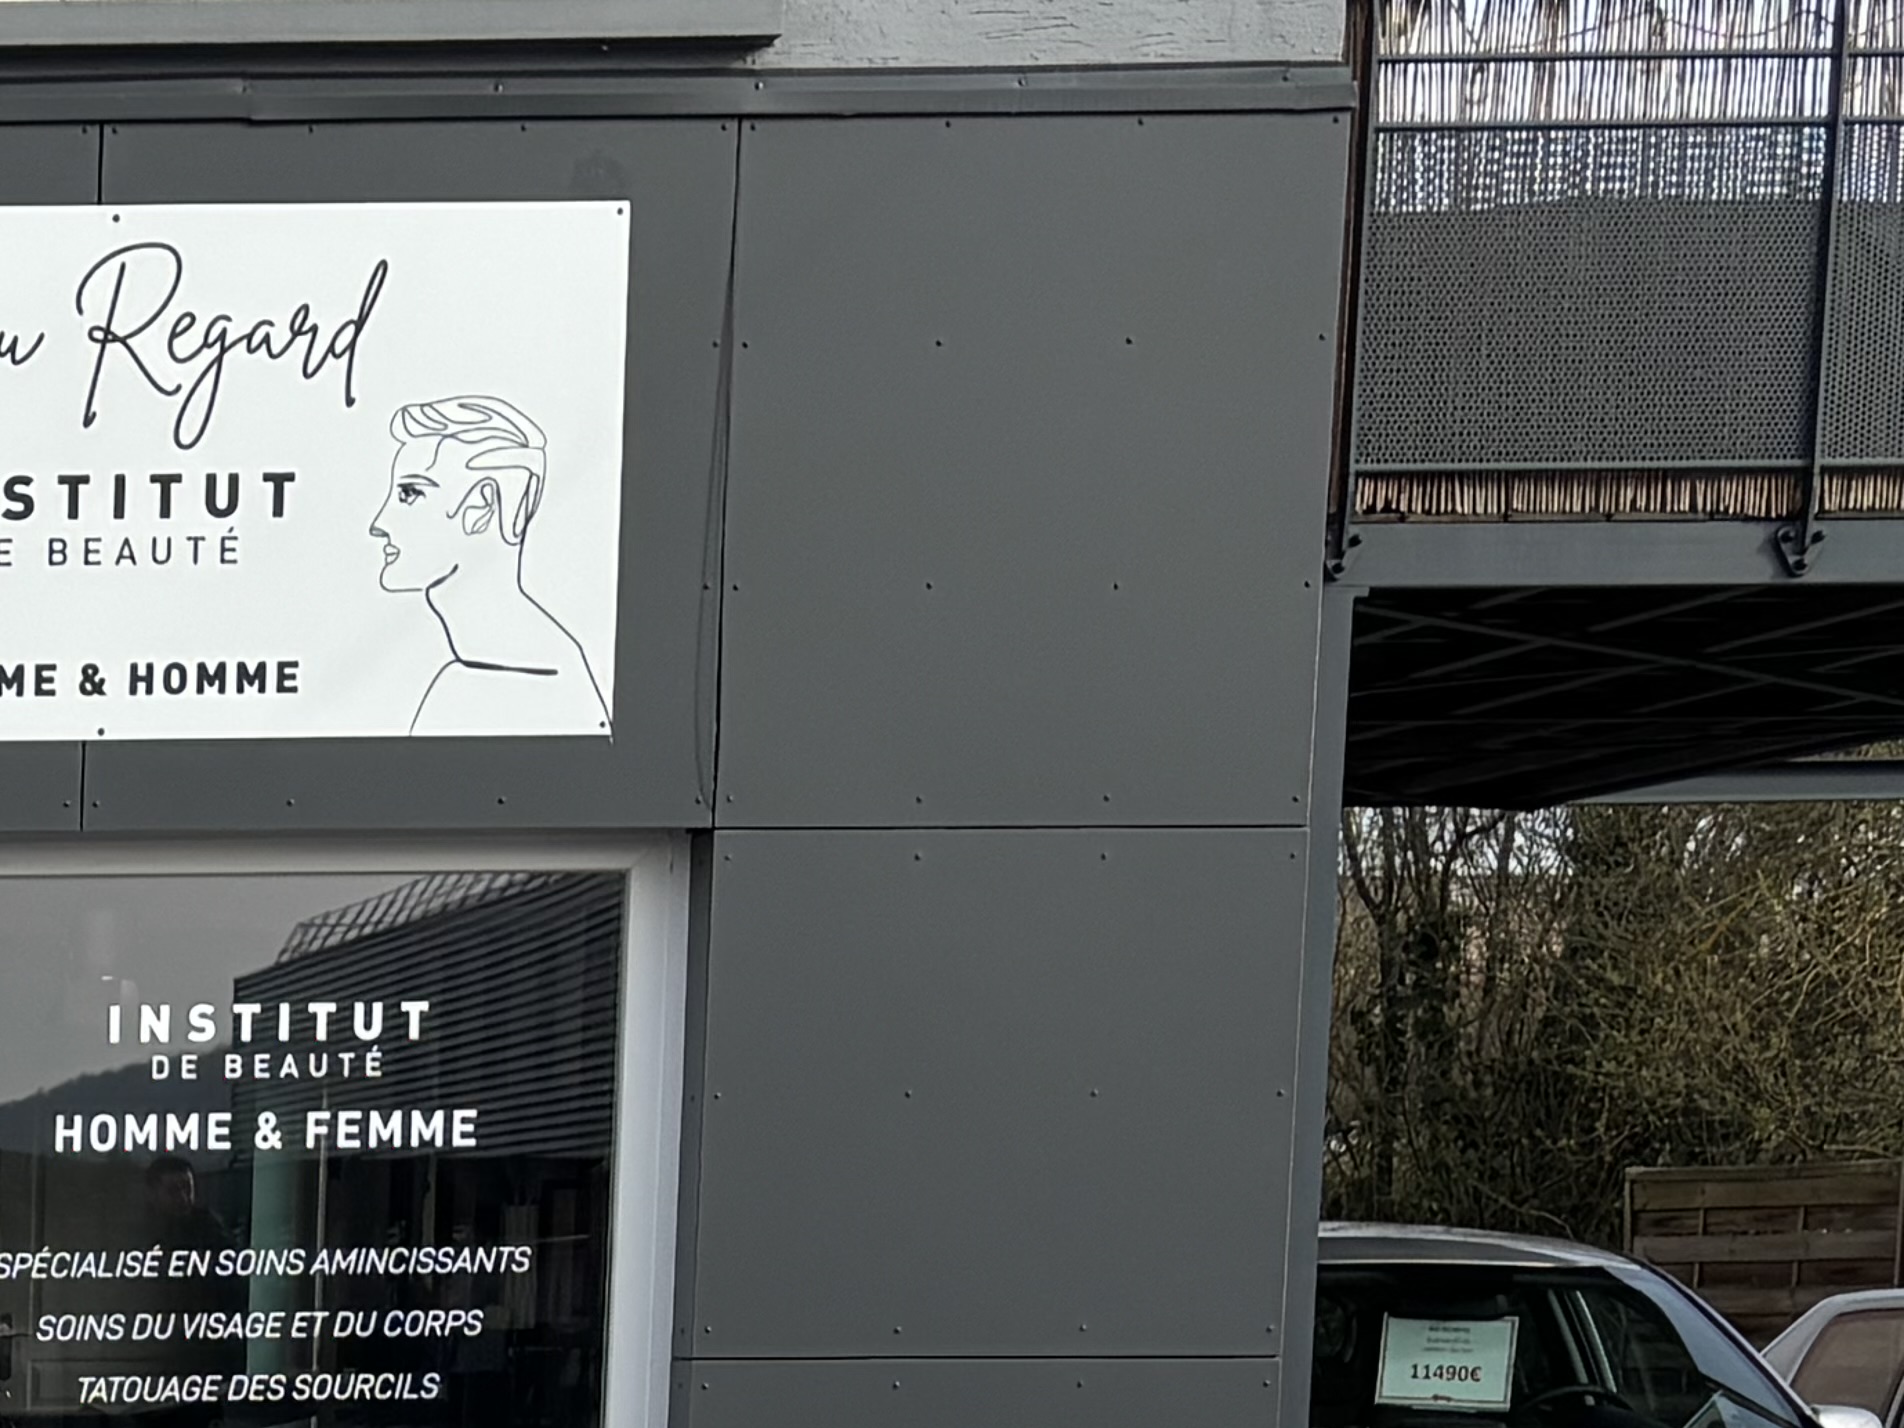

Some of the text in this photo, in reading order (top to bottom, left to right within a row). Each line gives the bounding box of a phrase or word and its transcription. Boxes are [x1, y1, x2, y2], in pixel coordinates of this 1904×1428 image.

[75, 243, 390, 450] Regard
[48, 527, 239, 567] BEAUTÉ
[78, 663, 107, 697] &
[128, 661, 299, 696] HOMME
[108, 1000, 430, 1045] INSTITUT
[151, 1044, 382, 1080] DE BEAUTÉ
[54, 1109, 478, 1153] HOMME & FEMME
[168, 1250, 210, 1277] EN
[215, 1248, 306, 1276] SOINS
[309, 1246, 532, 1275] AMINCISSANTS
[36, 1309, 484, 1342] SOINS DU VISAGE ET DU CORPS
[78, 1372, 441, 1404] TATOUAGE DES SOURCILS
[1410, 1363, 1482, 1383] 11490€
